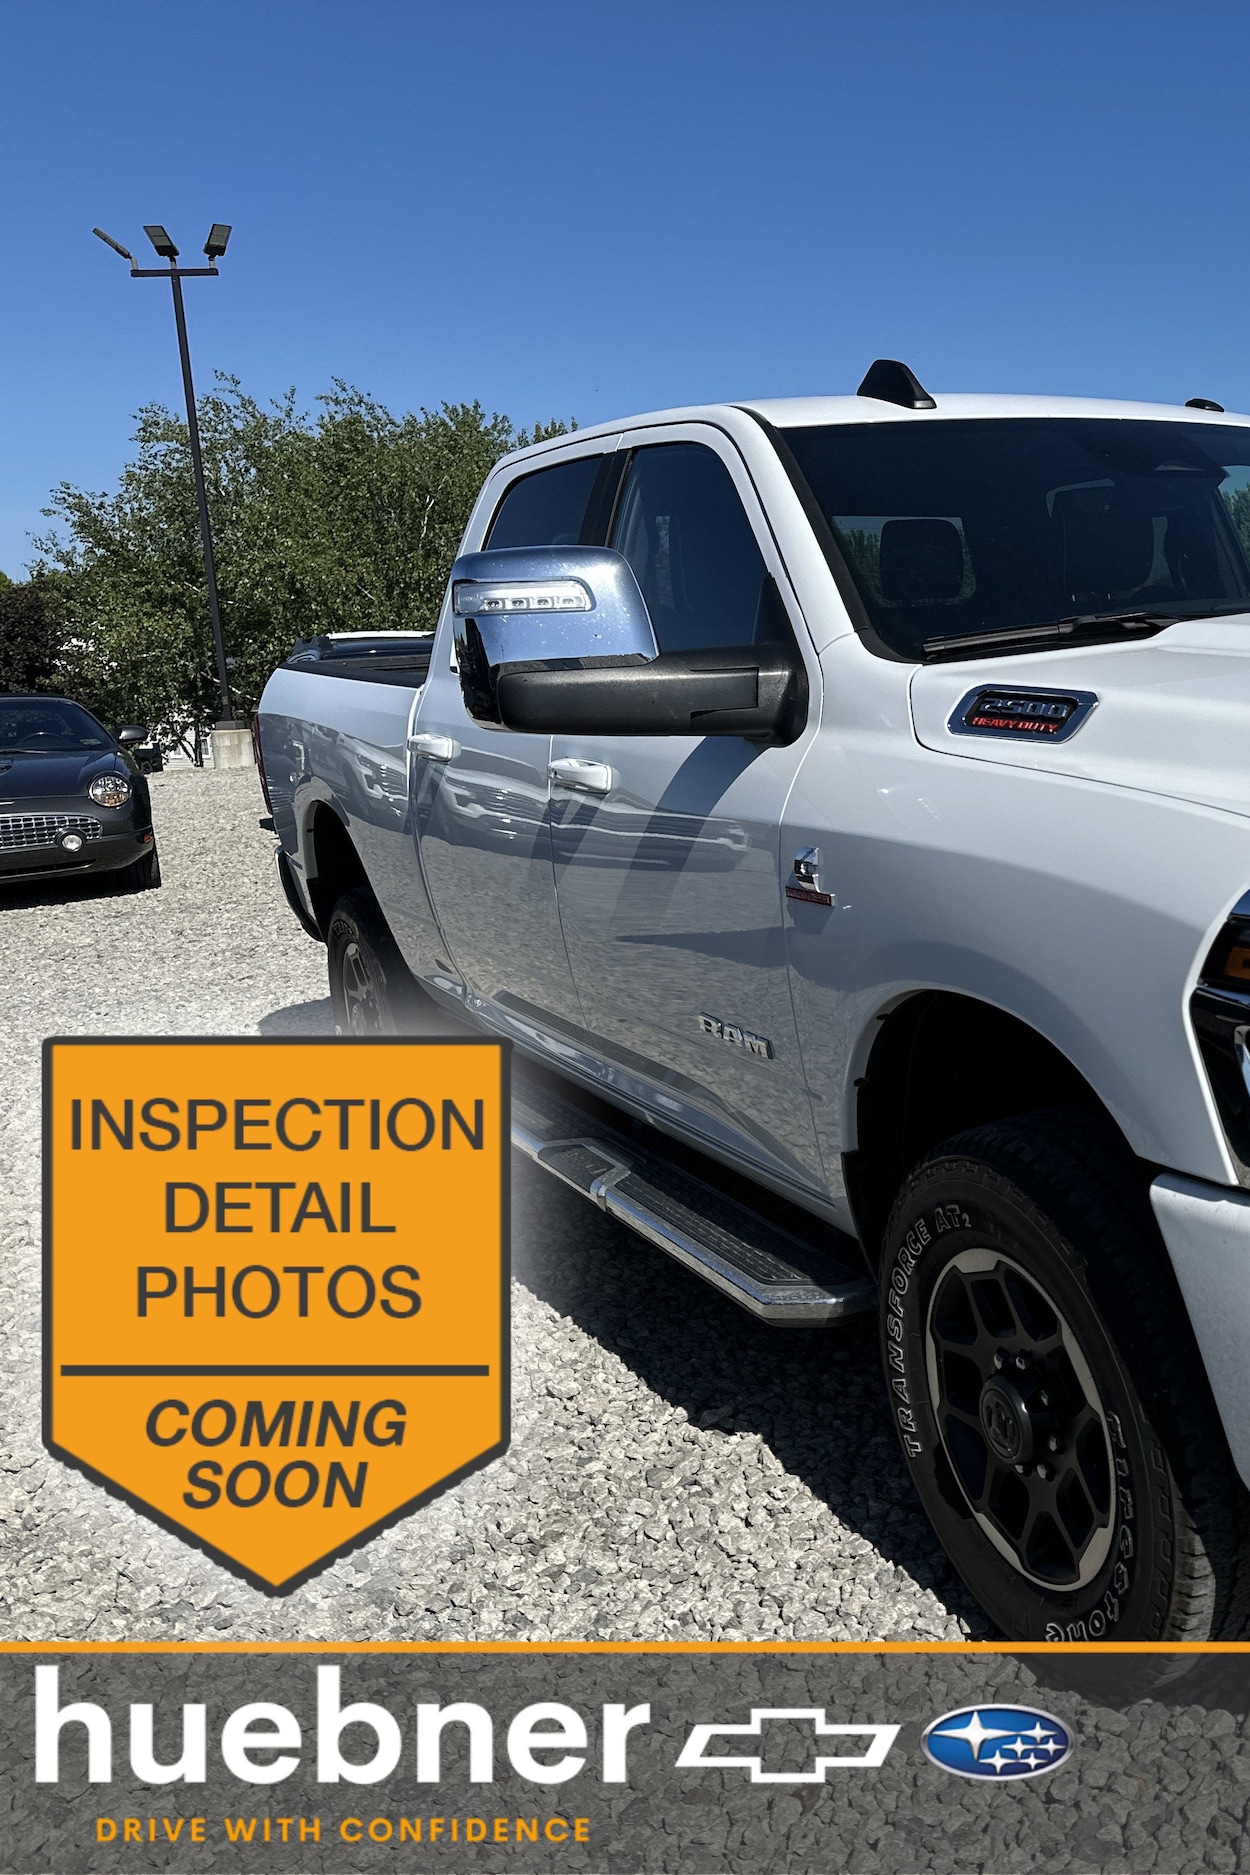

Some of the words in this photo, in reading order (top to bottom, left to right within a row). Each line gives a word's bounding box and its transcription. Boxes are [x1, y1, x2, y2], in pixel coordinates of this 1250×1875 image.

[971, 717, 1017, 729] HEAVY
[1017, 720, 1058, 733] DUTY
[978, 697, 1070, 719] 2500
[698, 1012, 773, 1060] RAM
[885, 1217, 934, 1458] TRANSFORCE
